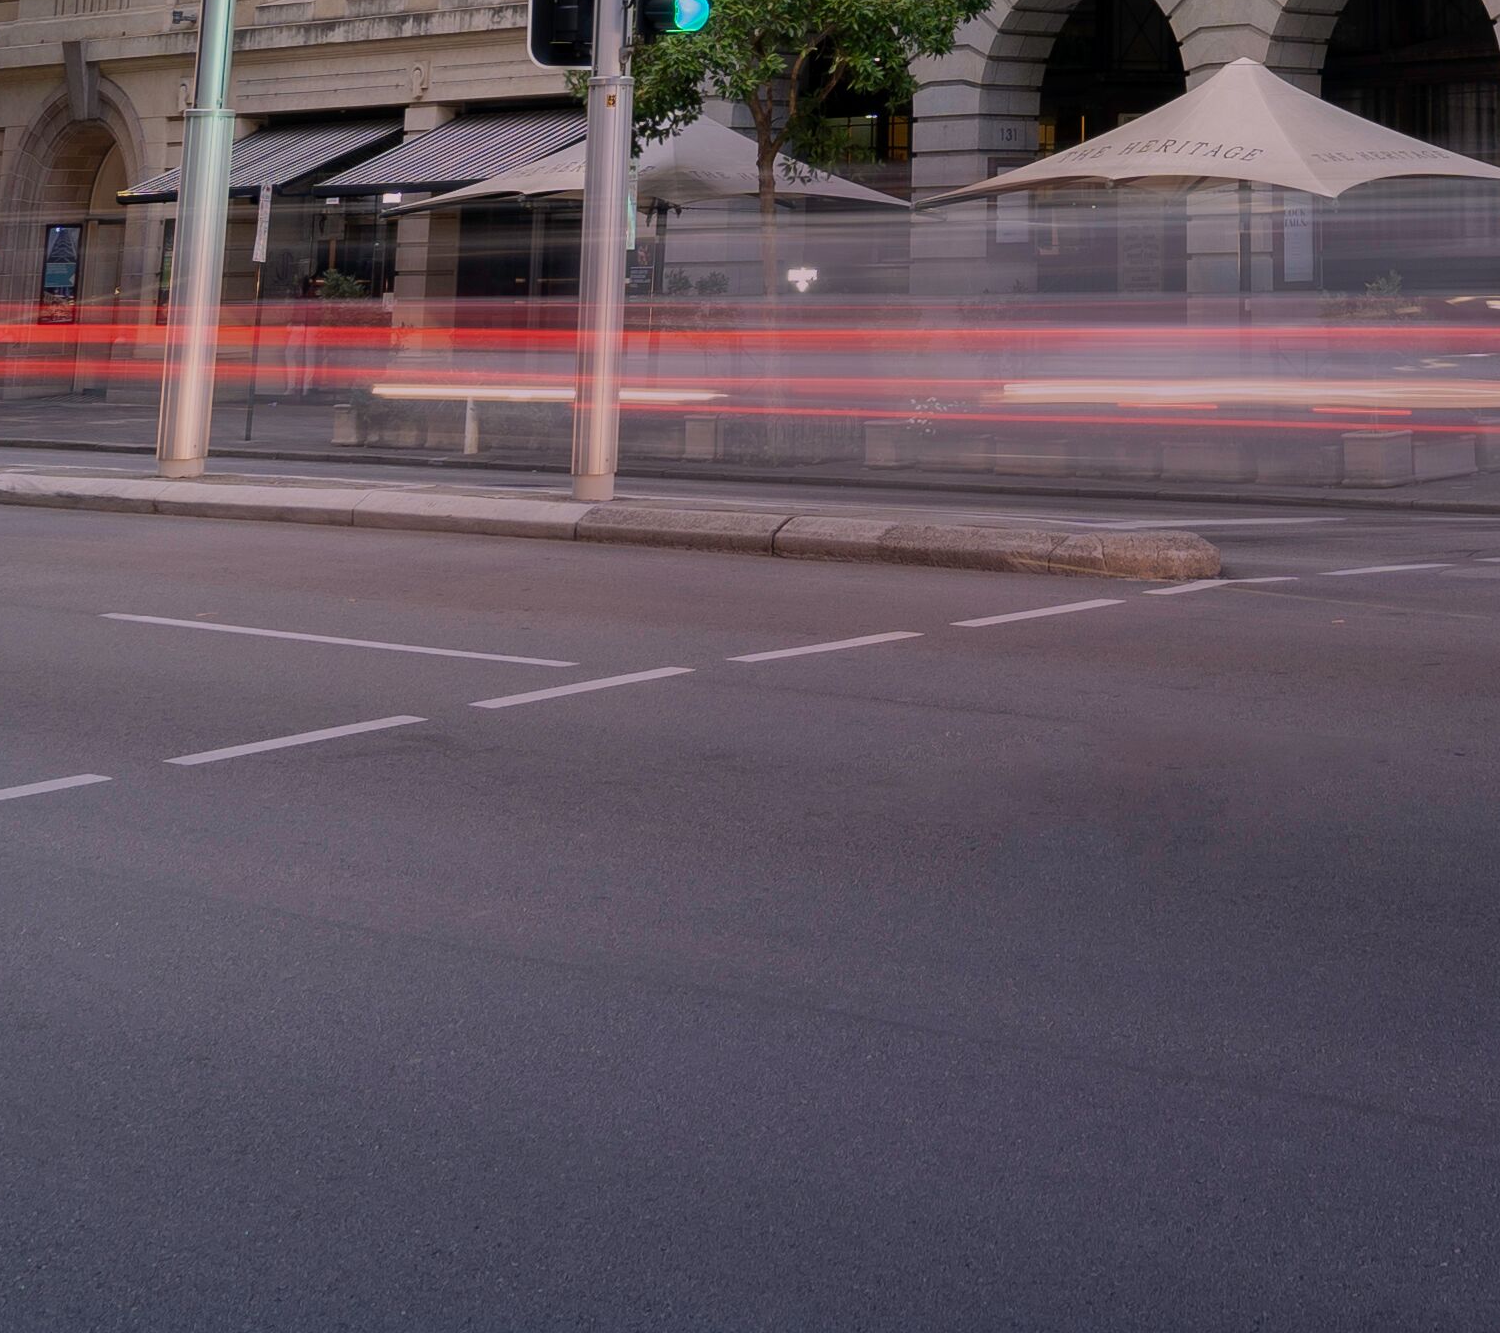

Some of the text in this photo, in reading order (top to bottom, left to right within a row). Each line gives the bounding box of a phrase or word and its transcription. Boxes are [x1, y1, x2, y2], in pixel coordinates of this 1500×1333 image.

[1000, 128, 1018, 142] 131
[1060, 139, 1264, 163] THE HERITAGE
